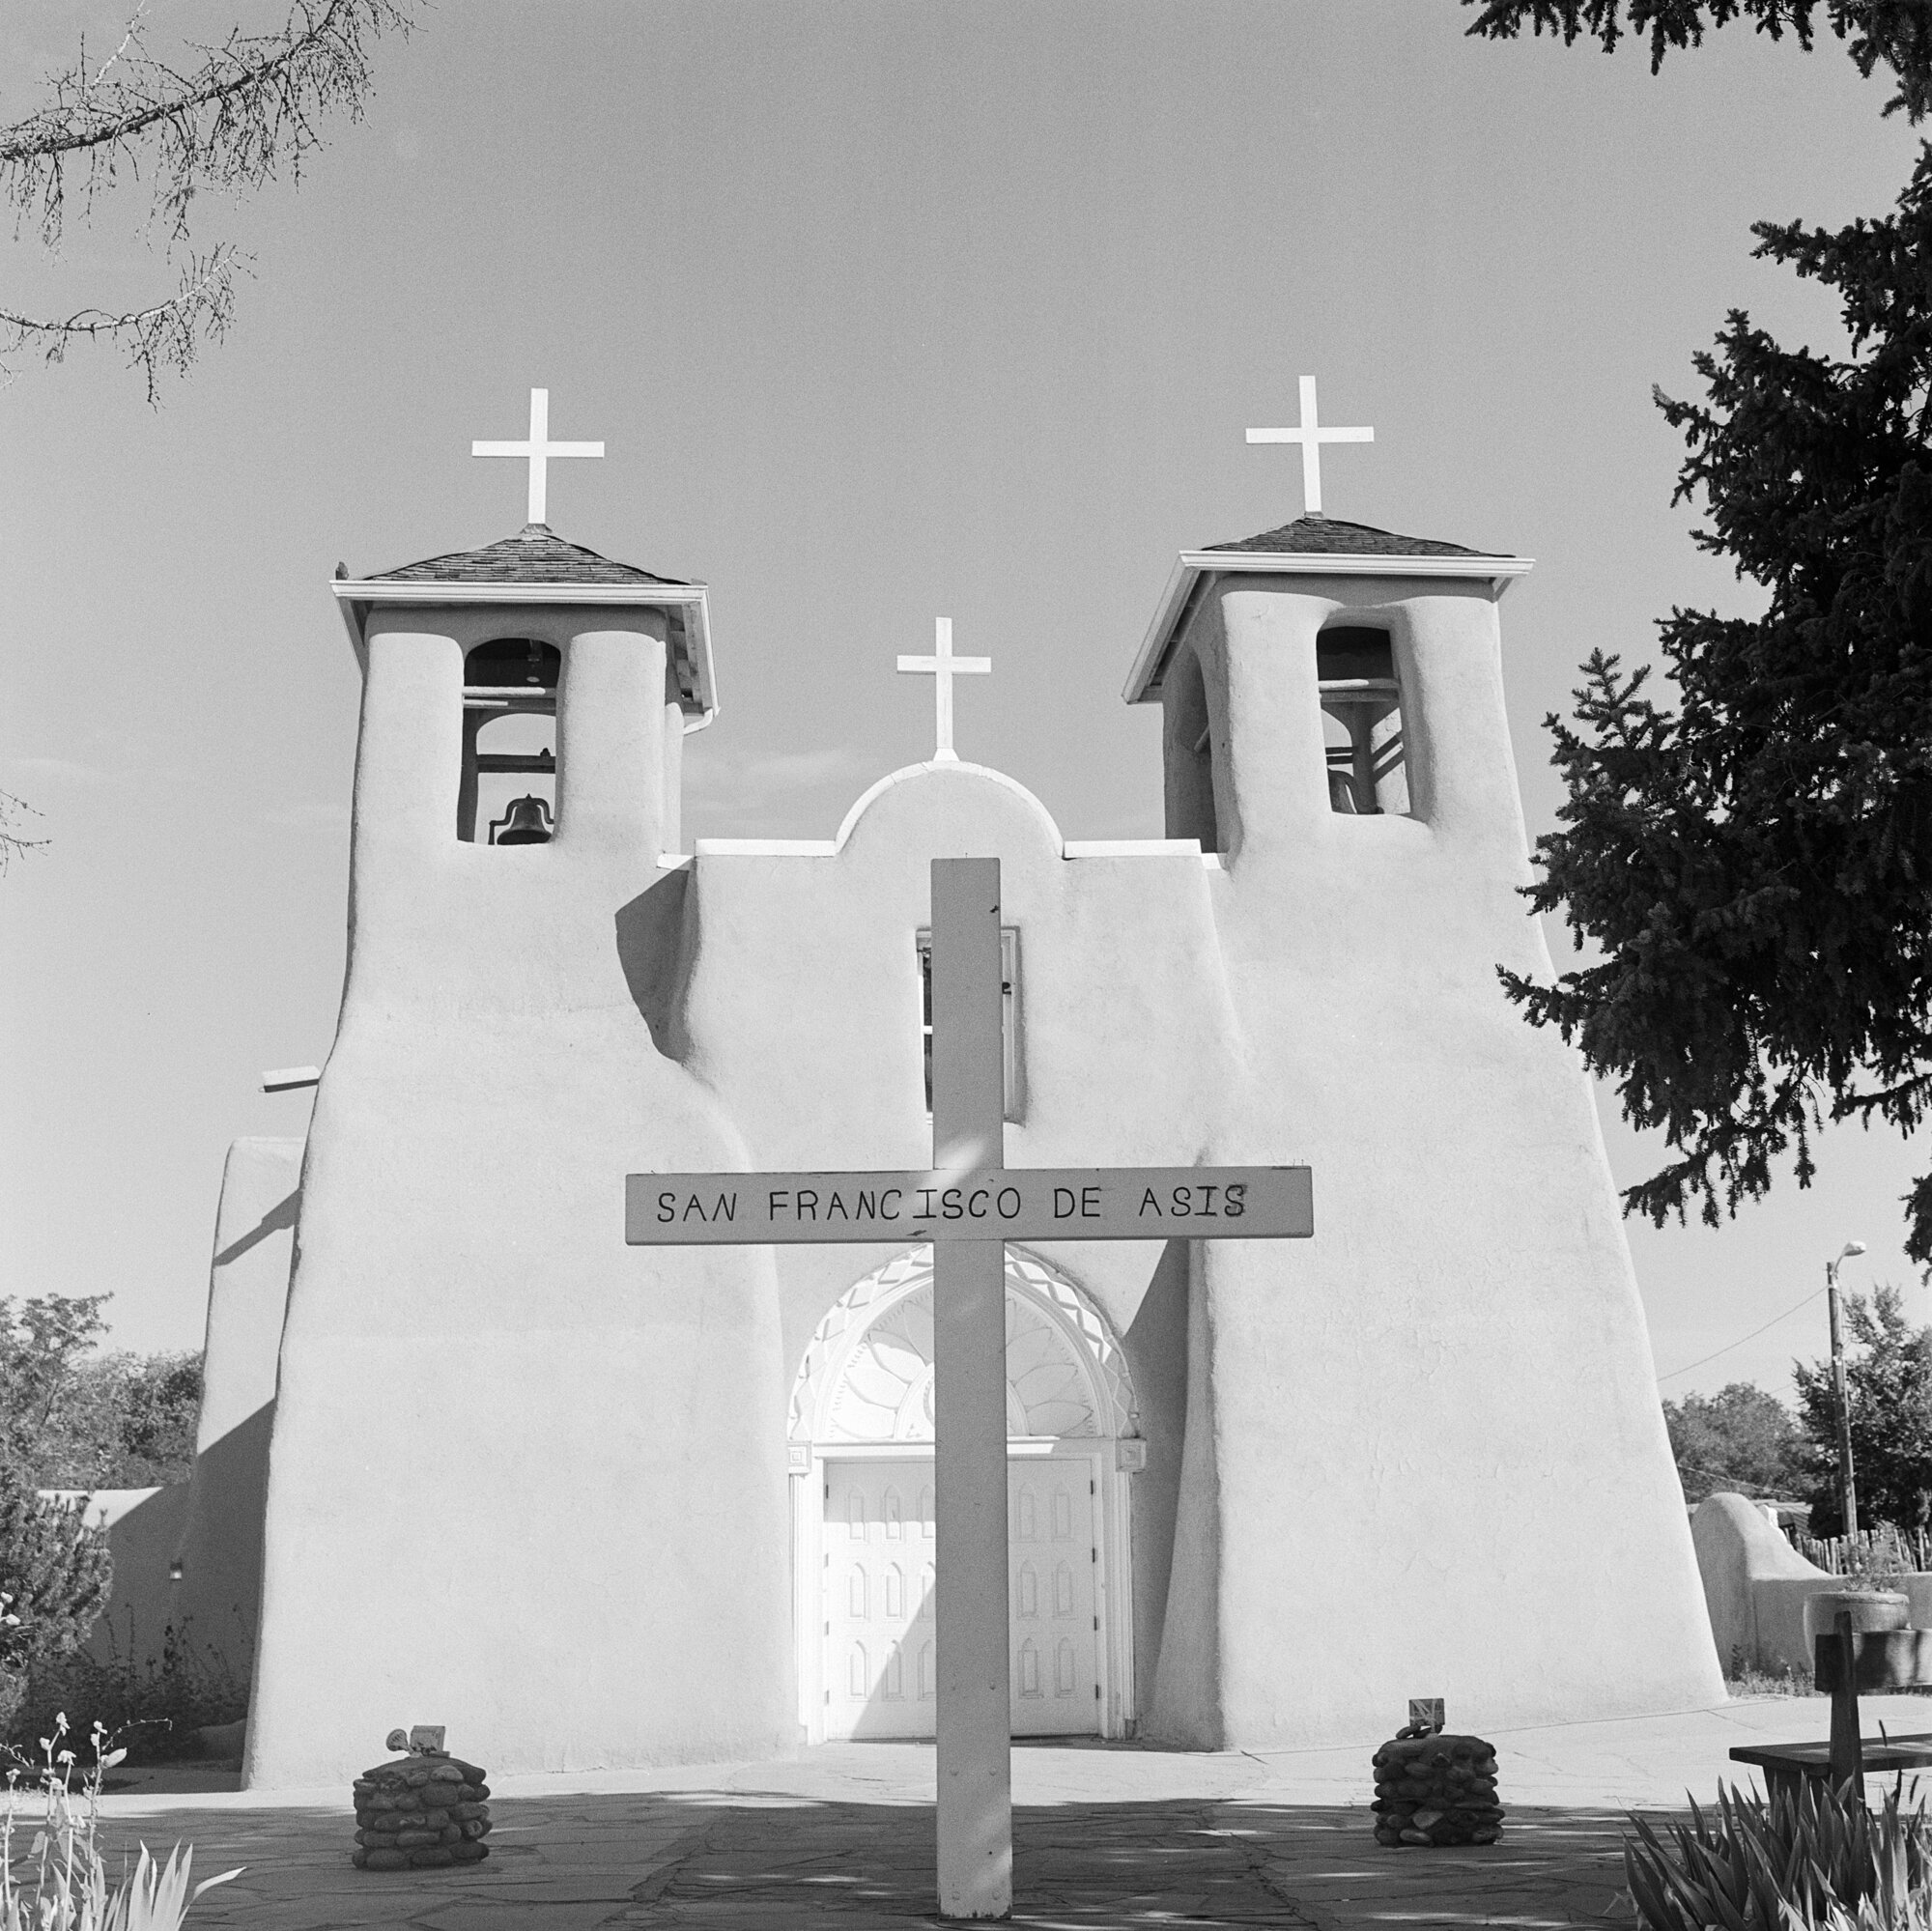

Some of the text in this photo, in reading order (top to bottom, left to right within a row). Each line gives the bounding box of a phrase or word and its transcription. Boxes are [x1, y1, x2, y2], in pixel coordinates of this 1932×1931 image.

[657, 1184, 1246, 1223] SAN FRANCISCO DE ASIS
